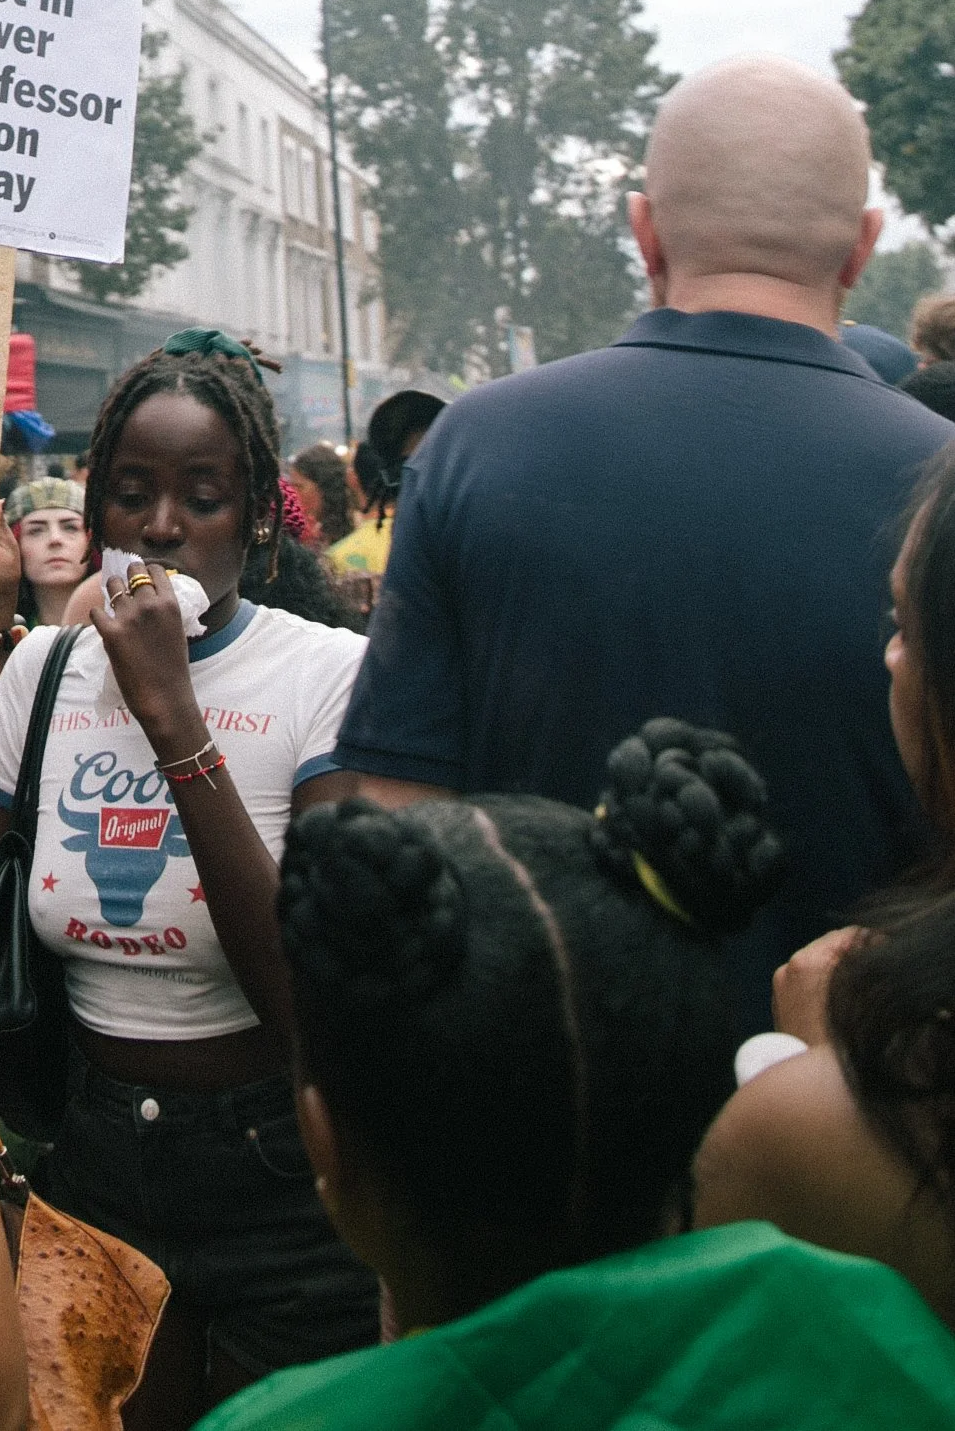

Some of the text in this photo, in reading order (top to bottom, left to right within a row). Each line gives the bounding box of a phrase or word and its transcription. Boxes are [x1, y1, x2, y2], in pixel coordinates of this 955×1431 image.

[50, 711, 92, 733] THIS
[202, 707, 277, 735] FIRST
[70, 751, 175, 804] Coo
[105, 812, 163, 841] Original
[64, 917, 187, 956] RODEO
